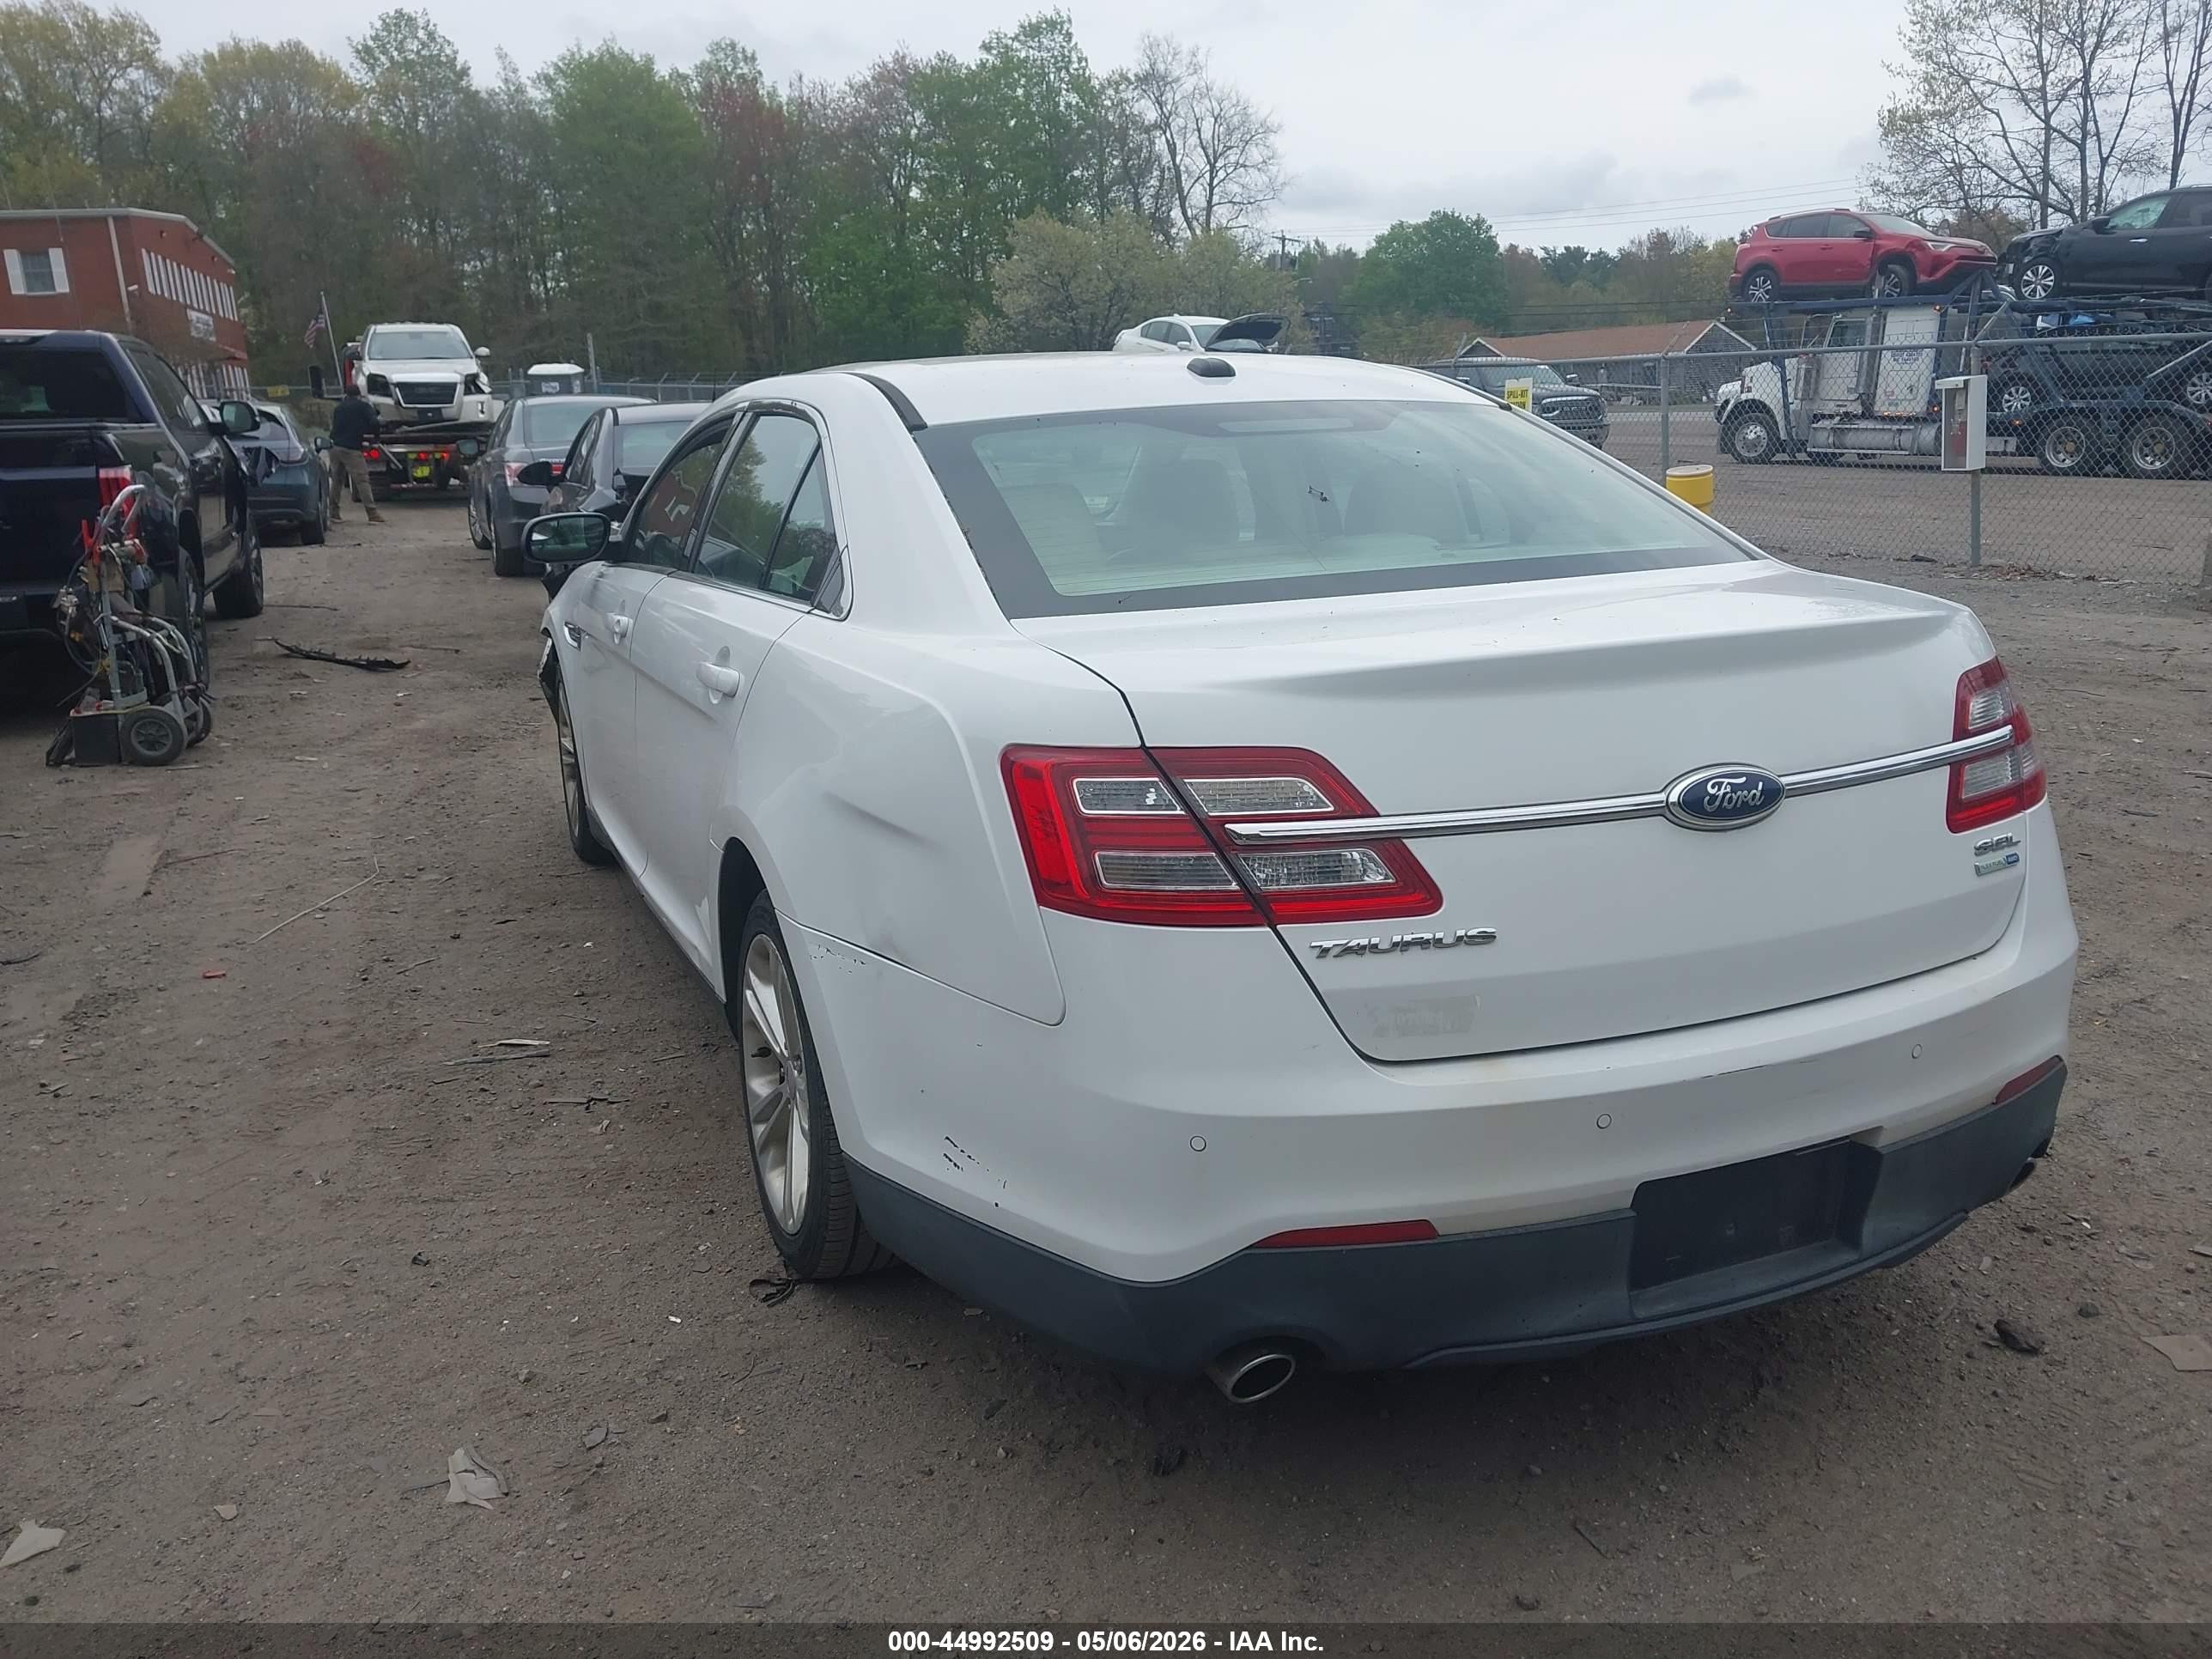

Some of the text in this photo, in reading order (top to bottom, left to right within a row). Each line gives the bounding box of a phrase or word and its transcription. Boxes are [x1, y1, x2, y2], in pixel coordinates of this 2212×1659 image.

[1704, 776, 1765, 811] Ford
[1974, 832, 2021, 856] SEL
[1310, 927, 1498, 958] TAURUS
